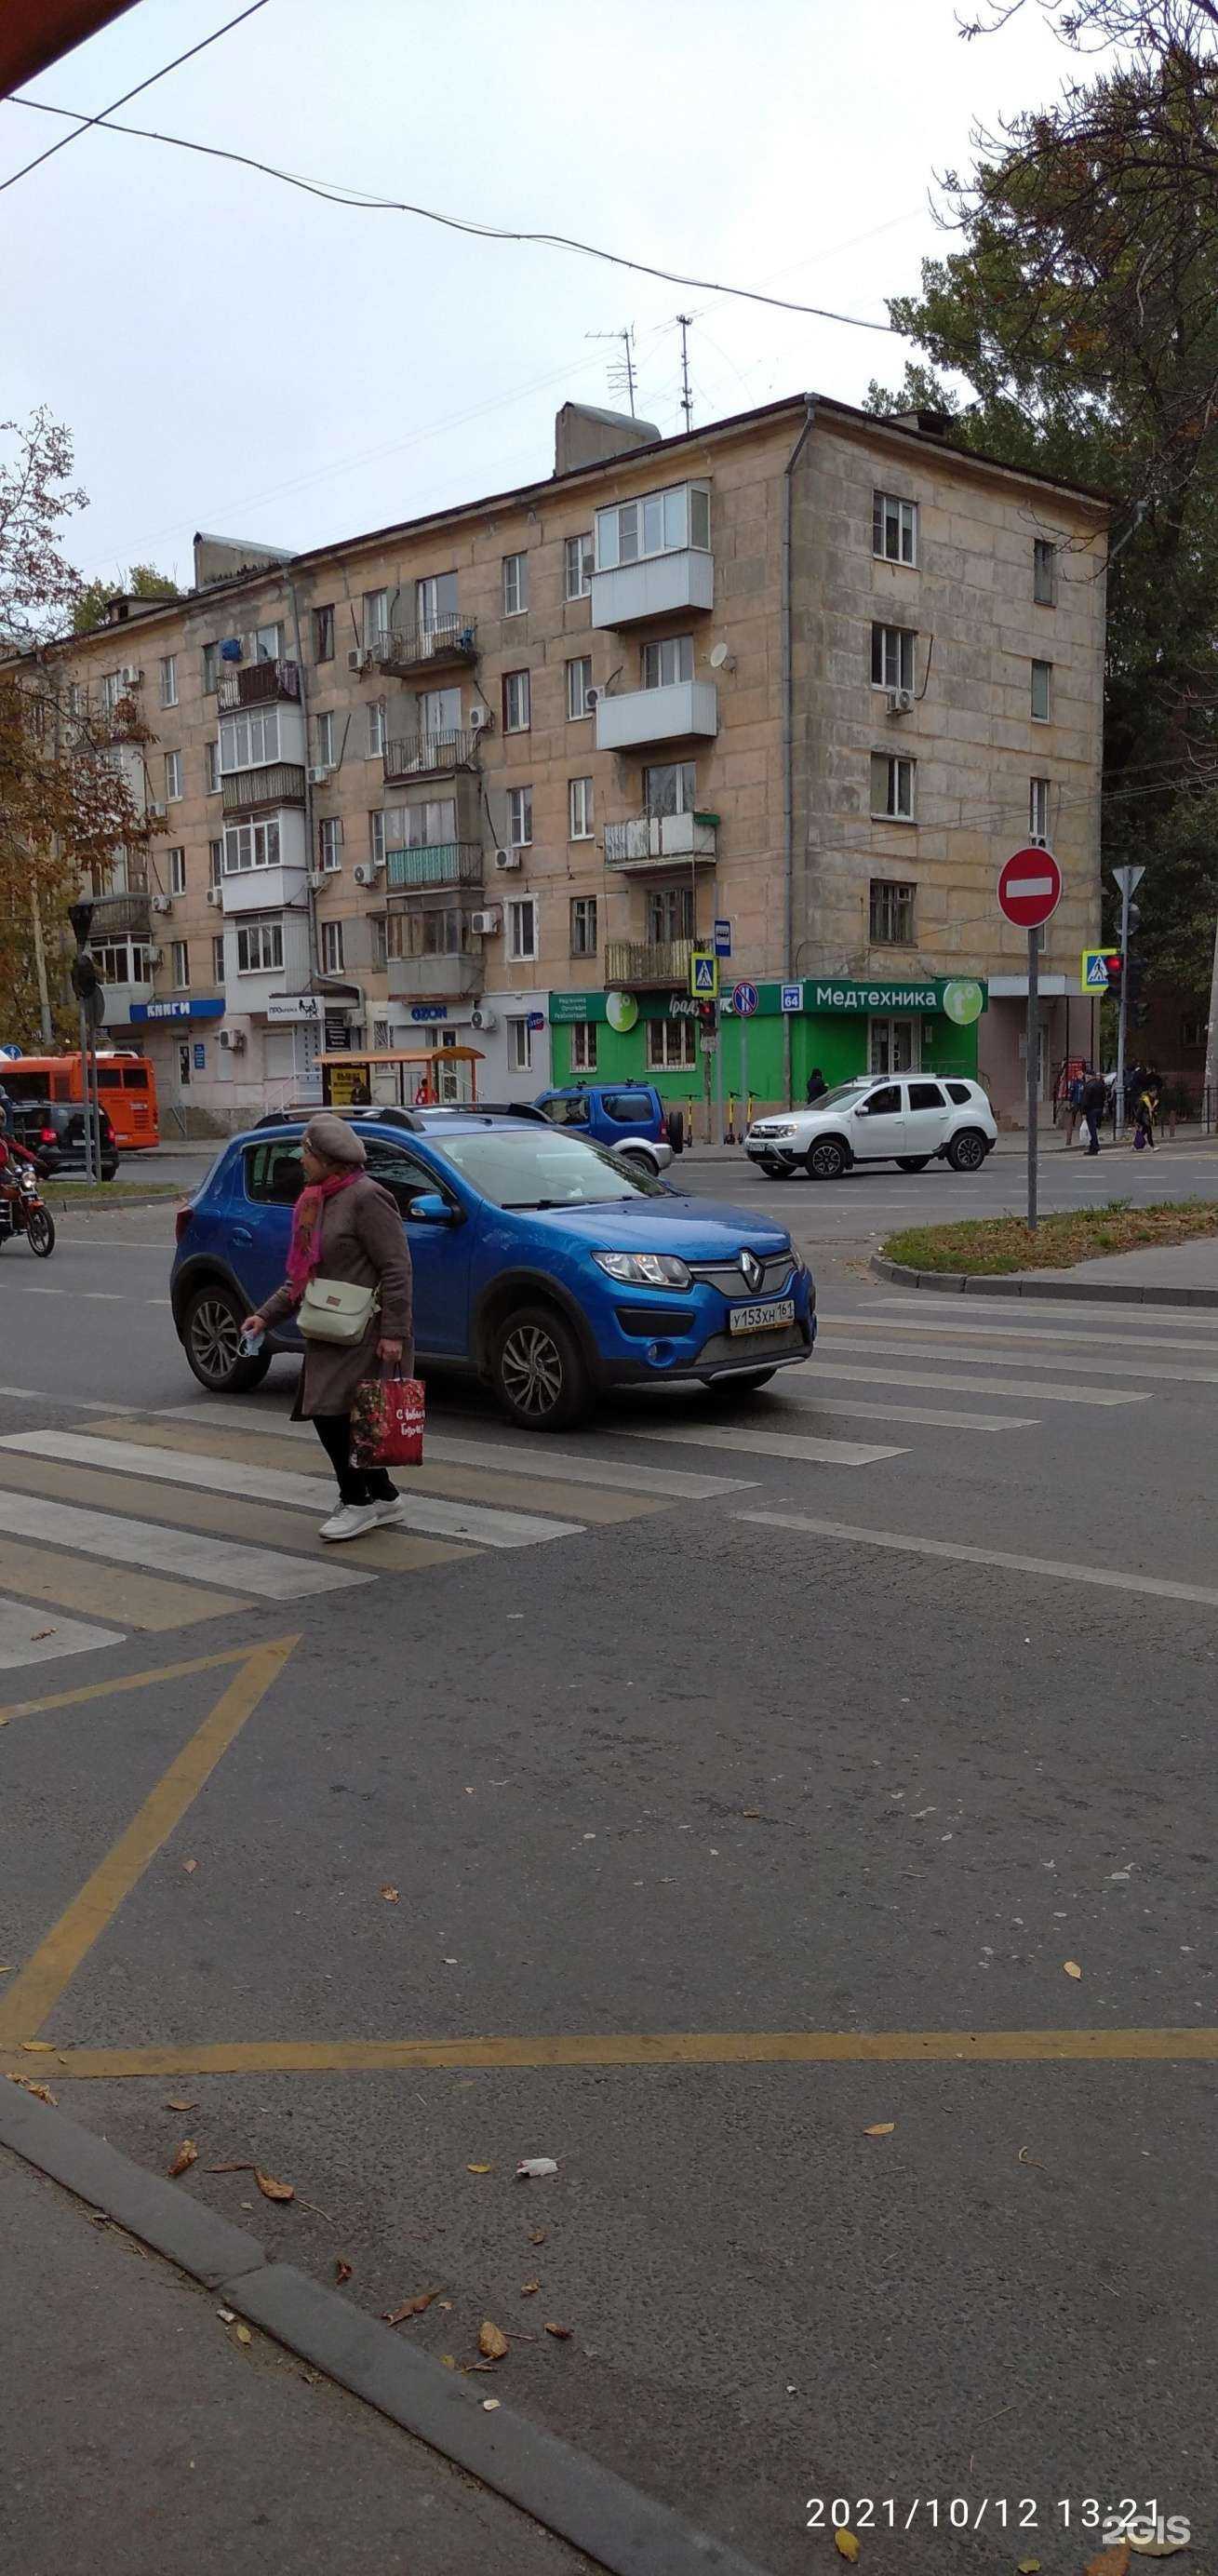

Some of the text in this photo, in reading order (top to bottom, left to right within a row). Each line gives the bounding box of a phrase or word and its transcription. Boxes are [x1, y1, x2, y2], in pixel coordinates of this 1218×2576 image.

[784, 996, 798, 1008] 64
[816, 986, 937, 1008] Медтехника
[147, 1002, 191, 1018] КНИГИ
[411, 1005, 448, 1022] OZON
